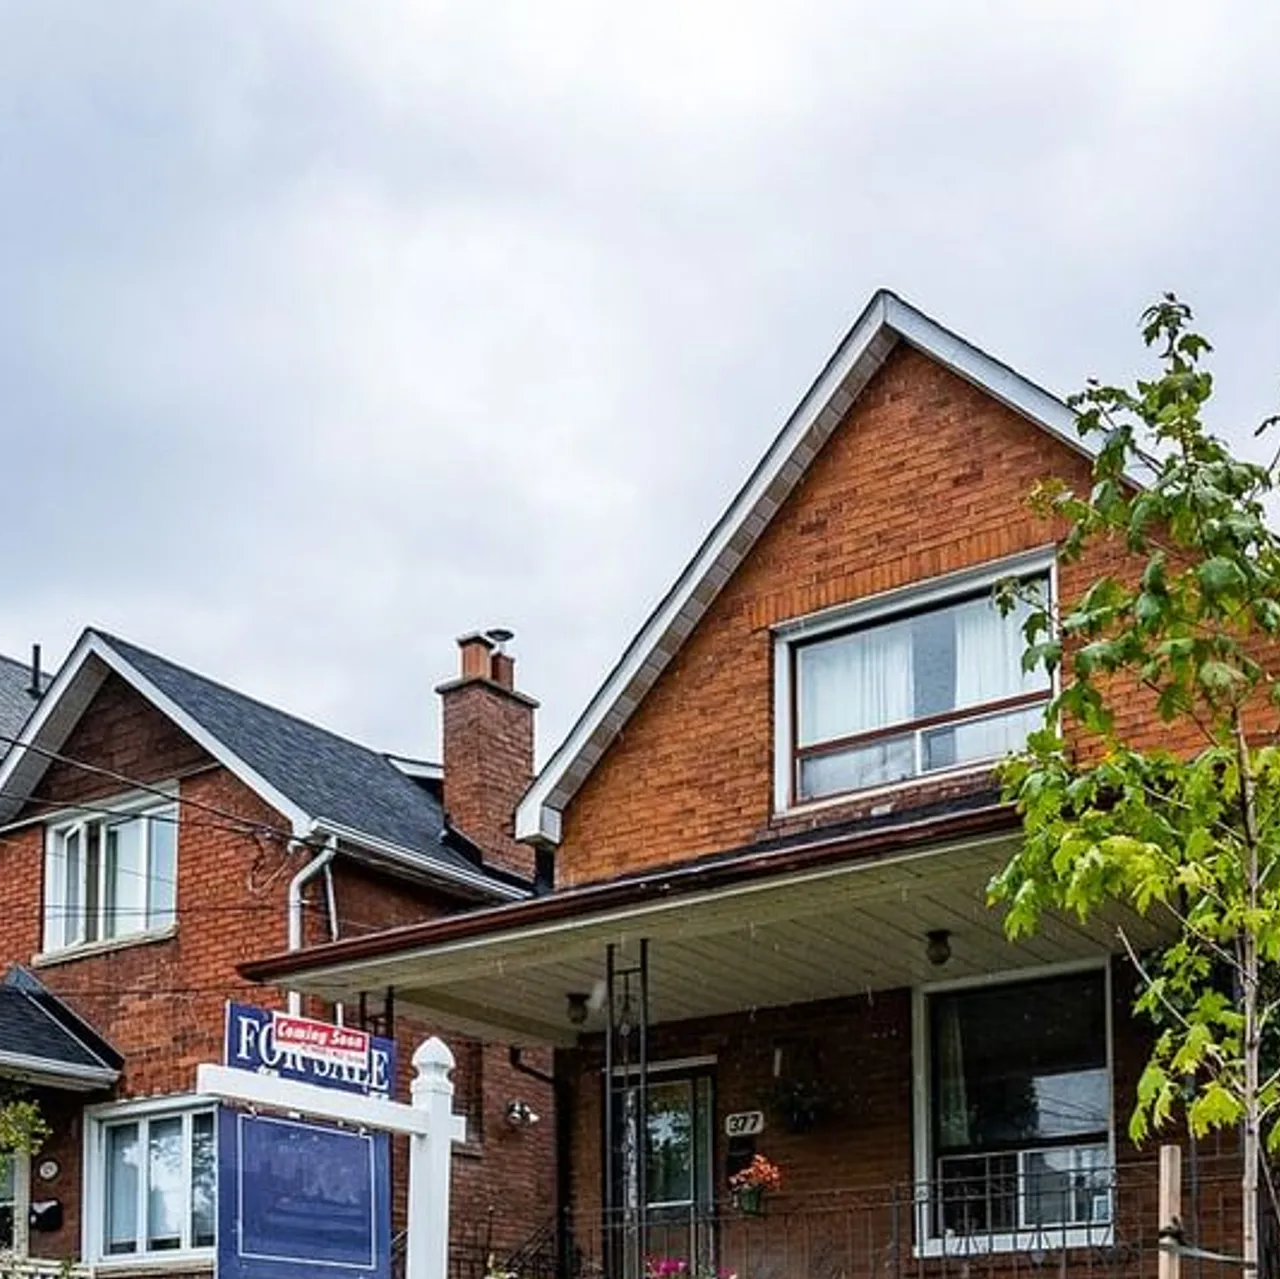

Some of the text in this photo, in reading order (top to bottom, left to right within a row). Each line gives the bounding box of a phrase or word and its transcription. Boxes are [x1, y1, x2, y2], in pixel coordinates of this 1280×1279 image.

[277, 1020, 363, 1048] Coming Soon
[729, 1113, 760, 1132] 377
